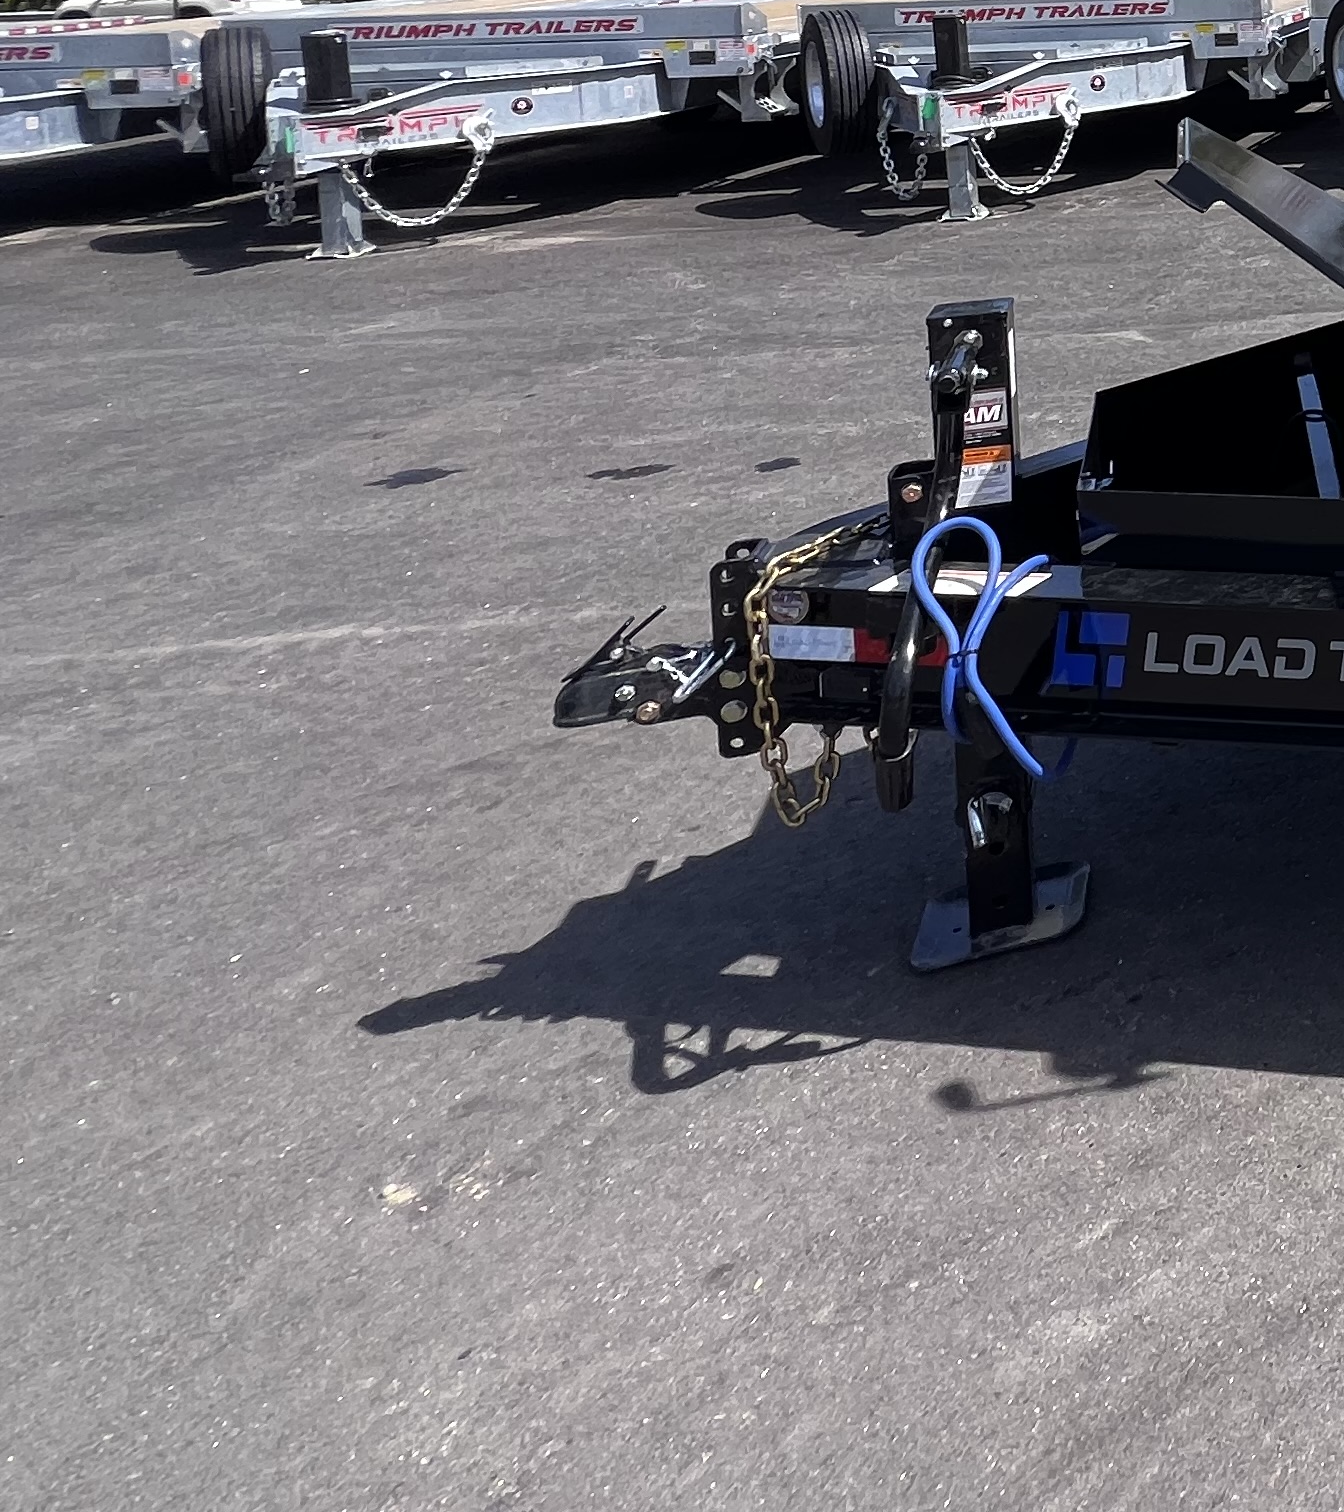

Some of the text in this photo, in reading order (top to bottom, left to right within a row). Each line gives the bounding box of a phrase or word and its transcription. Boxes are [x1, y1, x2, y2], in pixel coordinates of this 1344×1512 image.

[900, 0, 1170, 24] TRMPH TRAILERS
[336, 17, 638, 39] TRIUMPH TRAILERS
[0, 46, 54, 61] RS
[955, 92, 1057, 119] TRMP
[314, 114, 468, 145] TRMP
[1143, 631, 1316, 679] LOAD
